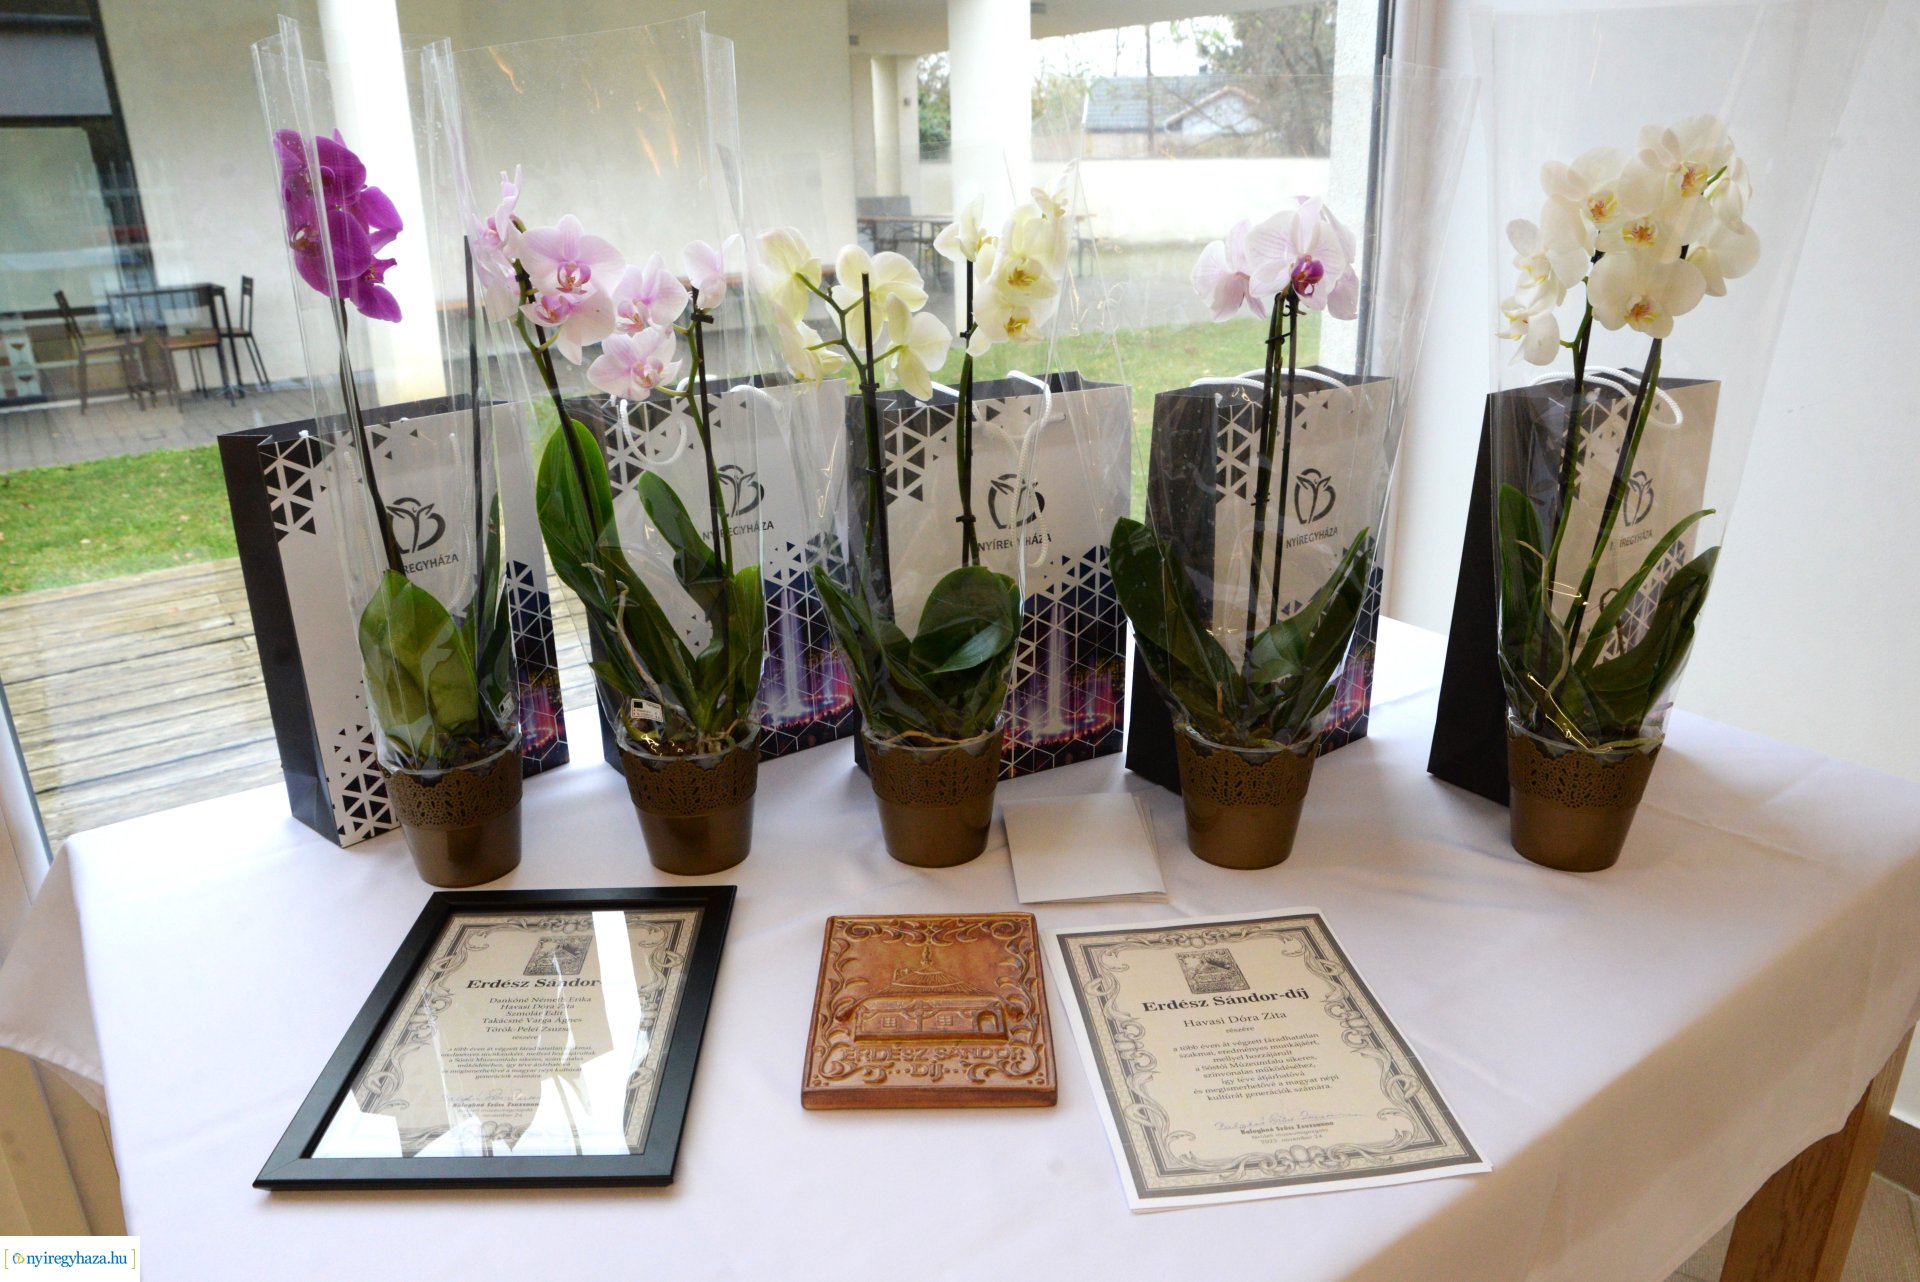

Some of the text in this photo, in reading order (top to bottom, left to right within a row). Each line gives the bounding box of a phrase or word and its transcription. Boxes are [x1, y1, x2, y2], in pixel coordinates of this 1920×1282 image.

[1285, 526, 1338, 549] NYÍREGYHÁZA
[466, 979, 531, 989] Erdész
[1141, 988, 1310, 1012] Erdész Sándor-díj
[1184, 1011, 1287, 1028] Havasi Dóra Zita
[1226, 1026, 1255, 1034] részére
[1200, 1042, 1220, 1050] éven
[1232, 1039, 1262, 1048] végzett
[1218, 1045, 1269, 1056] eredményes
[843, 1044, 929, 1062] ERDÉSZ
